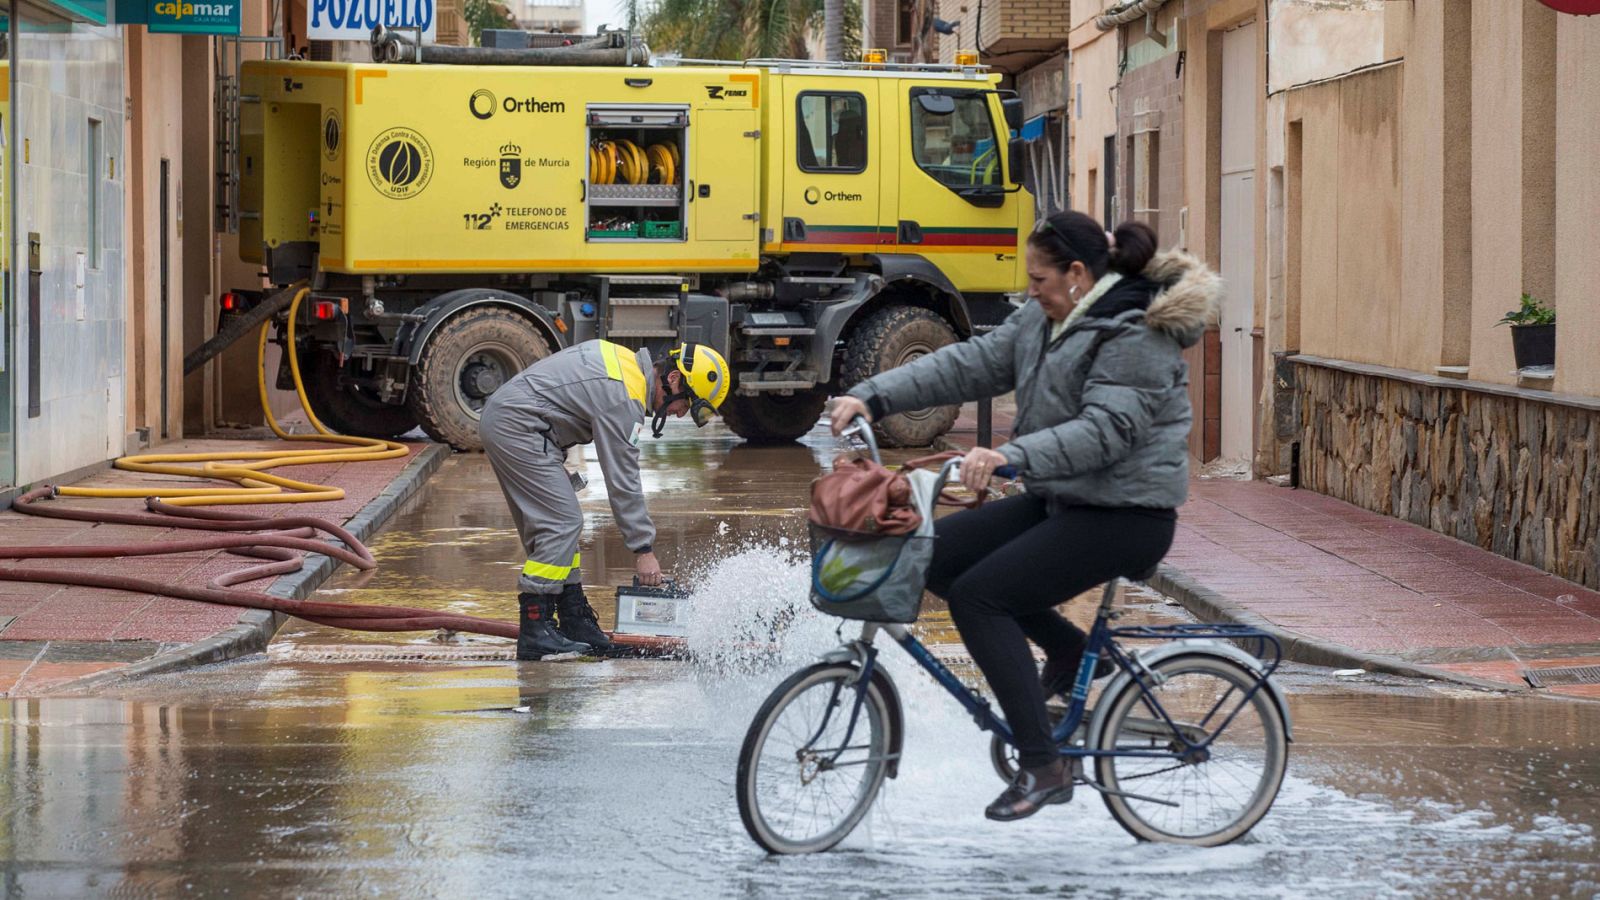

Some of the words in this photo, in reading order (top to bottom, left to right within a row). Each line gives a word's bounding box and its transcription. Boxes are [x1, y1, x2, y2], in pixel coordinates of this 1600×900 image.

[154, 0, 234, 20] cajamar
[311, 0, 433, 32] POZUELO
[503, 96, 565, 113] Orthem
[463, 157, 497, 169] Región
[524, 157, 536, 167] de
[538, 157, 570, 167] Murcia
[824, 190, 862, 201] Orthem
[463, 213, 492, 230] 112
[506, 207, 553, 217] TELEFONO
[555, 207, 567, 217] DE
[505, 221, 570, 231] EMERGENCIAS
